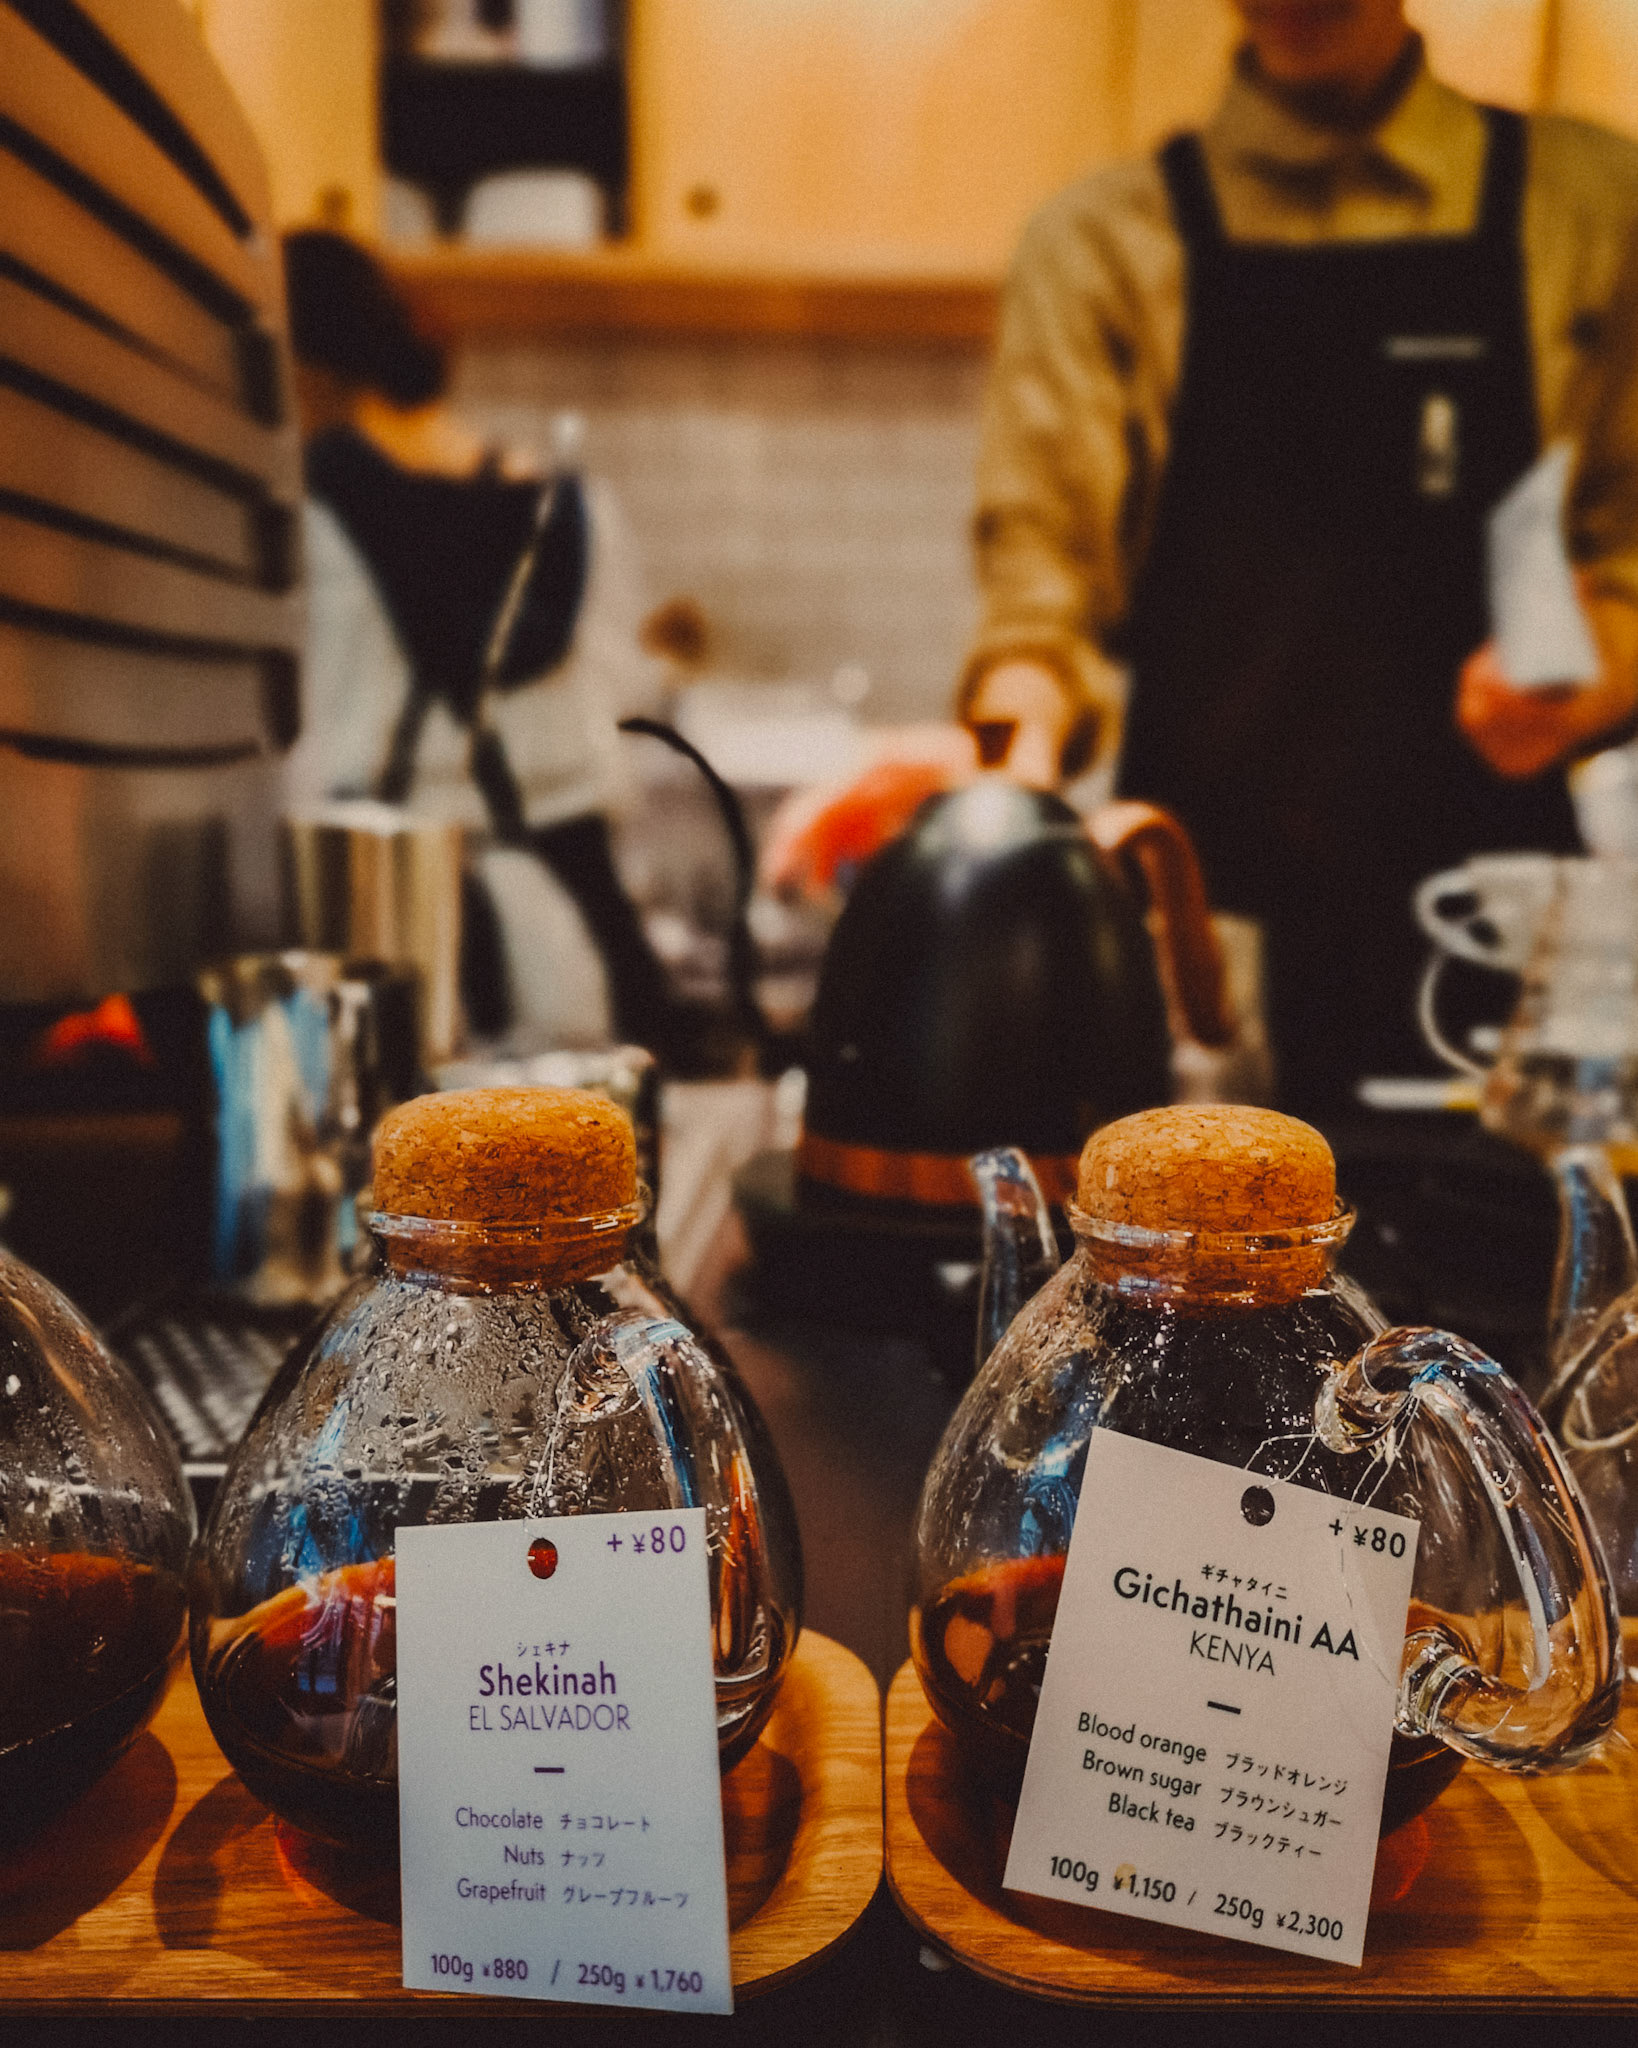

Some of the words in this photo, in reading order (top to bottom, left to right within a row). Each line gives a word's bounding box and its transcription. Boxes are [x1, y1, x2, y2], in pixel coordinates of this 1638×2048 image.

[633, 1525, 686, 1553] ¥80
[1354, 1525, 1406, 1557] ¥80
[1201, 1564, 1288, 1600] ギチャタイニ
[1114, 1567, 1303, 1645] Gichathaini
[1310, 1622, 1359, 1661] AA
[517, 1640, 571, 1657] シェキナ
[1189, 1630, 1275, 1677] KENYA
[479, 1660, 617, 1696] Shekinah
[470, 1705, 493, 1731] EL
[500, 1704, 631, 1731] SALVADOR
[1077, 1712, 1136, 1744] Blood
[1140, 1733, 1207, 1764] orange
[1082, 1749, 1144, 1784] Brown
[1150, 1770, 1202, 1797] sugar
[1225, 1752, 1348, 1796] ブラッドオレンジ
[455, 1807, 543, 1830] Chocolate
[560, 1812, 651, 1832] チョコレート
[1108, 1793, 1160, 1824] Black
[1165, 1808, 1196, 1832] tea
[1220, 1787, 1342, 1828] ブラウンシュガー
[504, 1846, 545, 1866] Nuts
[1214, 1822, 1322, 1858] ブラックティー
[561, 1851, 605, 1868] ナッツ
[457, 1878, 546, 1904] Grapefruit
[563, 1885, 690, 1908] グレープフルーツ
[1050, 1856, 1099, 1892] 100g
[1113, 1873, 1176, 1902] ¥1,150
[1214, 1894, 1264, 1928] 250g
[1276, 1910, 1344, 1941] ¥2,300
[431, 1954, 474, 1982] 100g
[483, 1958, 529, 1981] ¥880
[578, 1963, 626, 1994] 250g
[636, 1969, 703, 1994] ¥1,760
